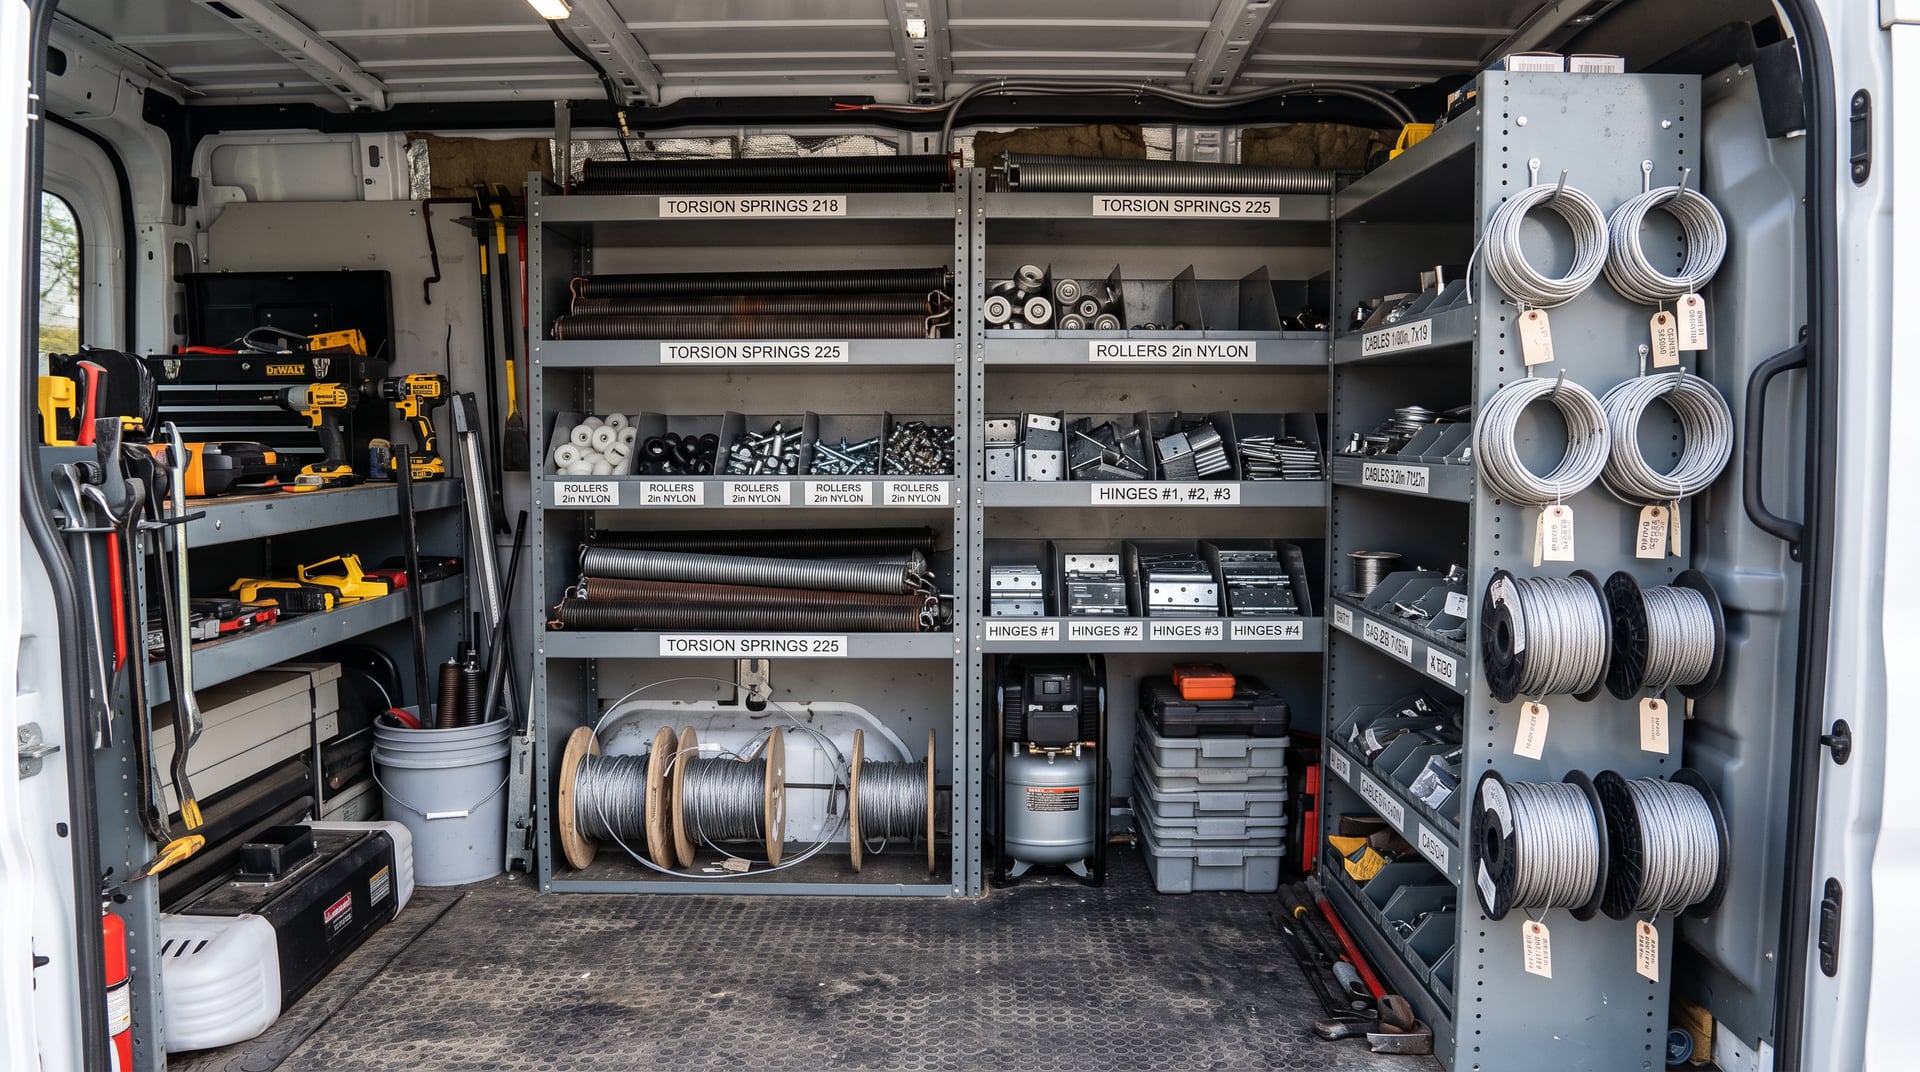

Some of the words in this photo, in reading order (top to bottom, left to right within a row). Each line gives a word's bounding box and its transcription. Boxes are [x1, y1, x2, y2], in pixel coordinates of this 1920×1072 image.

[666, 199, 736, 214] TORSION
[740, 199, 809, 214] SPRINGS
[812, 199, 839, 213] 218
[1100, 198, 1169, 213] TORSION
[1173, 199, 1242, 214] SPRINGS
[1245, 200, 1272, 214] 225
[1365, 332, 1390, 352] CABLES
[1411, 324, 1428, 343] 7x19
[668, 345, 737, 359] TORSION
[742, 345, 810, 359] SPRINGS
[814, 345, 841, 359] 225
[1097, 344, 1168, 358] ROLLERS
[1171, 344, 1192, 358] 2in
[1197, 344, 1249, 358] NYLON
[1364, 466, 1390, 483] CABLES
[564, 484, 609, 493] ROLLERS
[649, 483, 695, 493] ROLLERS
[734, 483, 779, 493] ROLLERS
[816, 483, 862, 493] ROLLERS
[893, 483, 939, 493] ROLLERS
[562, 494, 576, 503] 2in
[578, 494, 611, 503] NYLON
[647, 494, 661, 503] 2in
[663, 494, 696, 503] NYLON
[732, 494, 746, 503] 2in
[748, 494, 781, 503] NYLON
[814, 494, 828, 503] 2in
[830, 494, 864, 503] NYLON
[891, 494, 905, 503] 2in
[907, 494, 941, 503] NYLON
[1100, 487, 1158, 500] HINGES
[1161, 487, 1184, 502] #1,
[1187, 487, 1210, 503] #2,
[1213, 487, 1231, 501] #3
[989, 625, 1038, 637] HINGES
[1040, 625, 1054, 637] #1
[1072, 625, 1121, 637] HINGES
[1123, 625, 1138, 637] #2
[1153, 625, 1202, 636] HINGES
[1204, 625, 1219, 636] #3
[1234, 625, 1283, 636] HINGES
[1284, 625, 1300, 636] #4
[666, 638, 736, 653] TORSION
[740, 639, 809, 653] SPRINGS
[812, 639, 839, 653] 225
